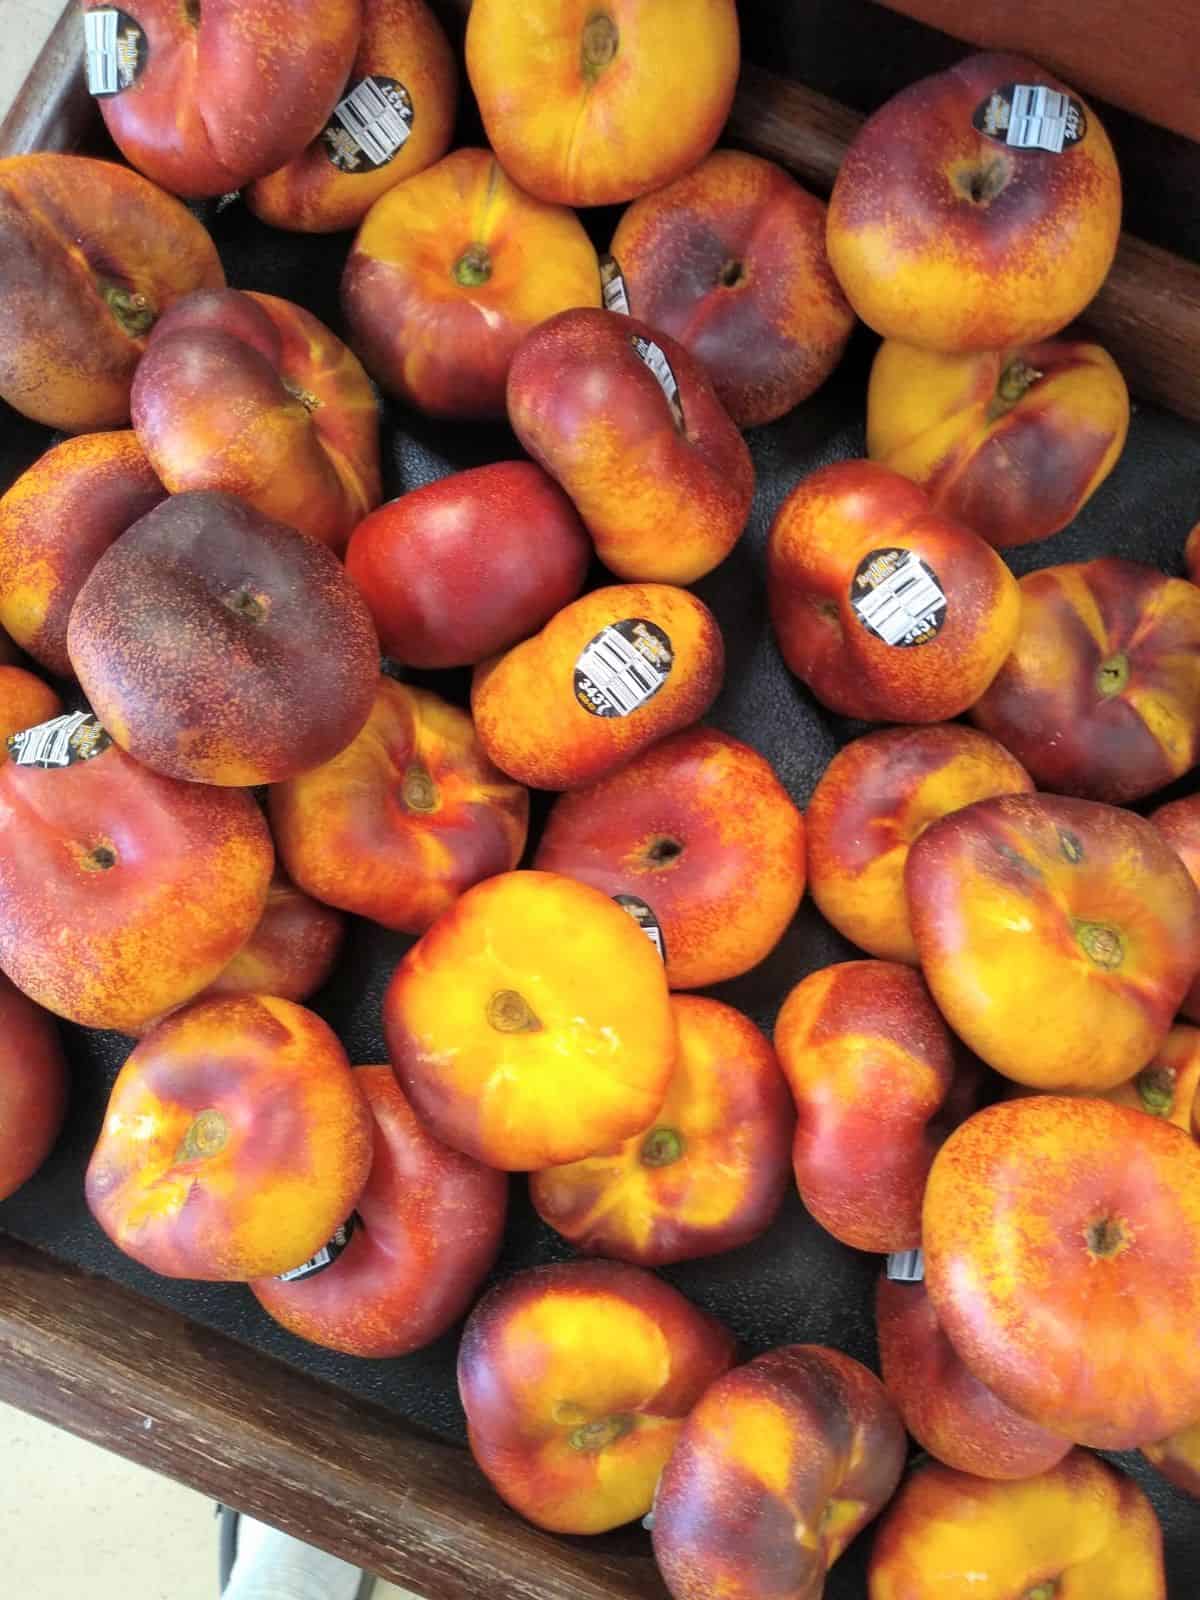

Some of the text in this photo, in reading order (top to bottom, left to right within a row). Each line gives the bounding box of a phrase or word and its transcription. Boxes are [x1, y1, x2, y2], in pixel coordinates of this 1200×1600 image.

[381, 85, 412, 118] 3437
[1063, 105, 1080, 140] 3437
[904, 613, 937, 643] 3437
[578, 678, 612, 714] 3437
